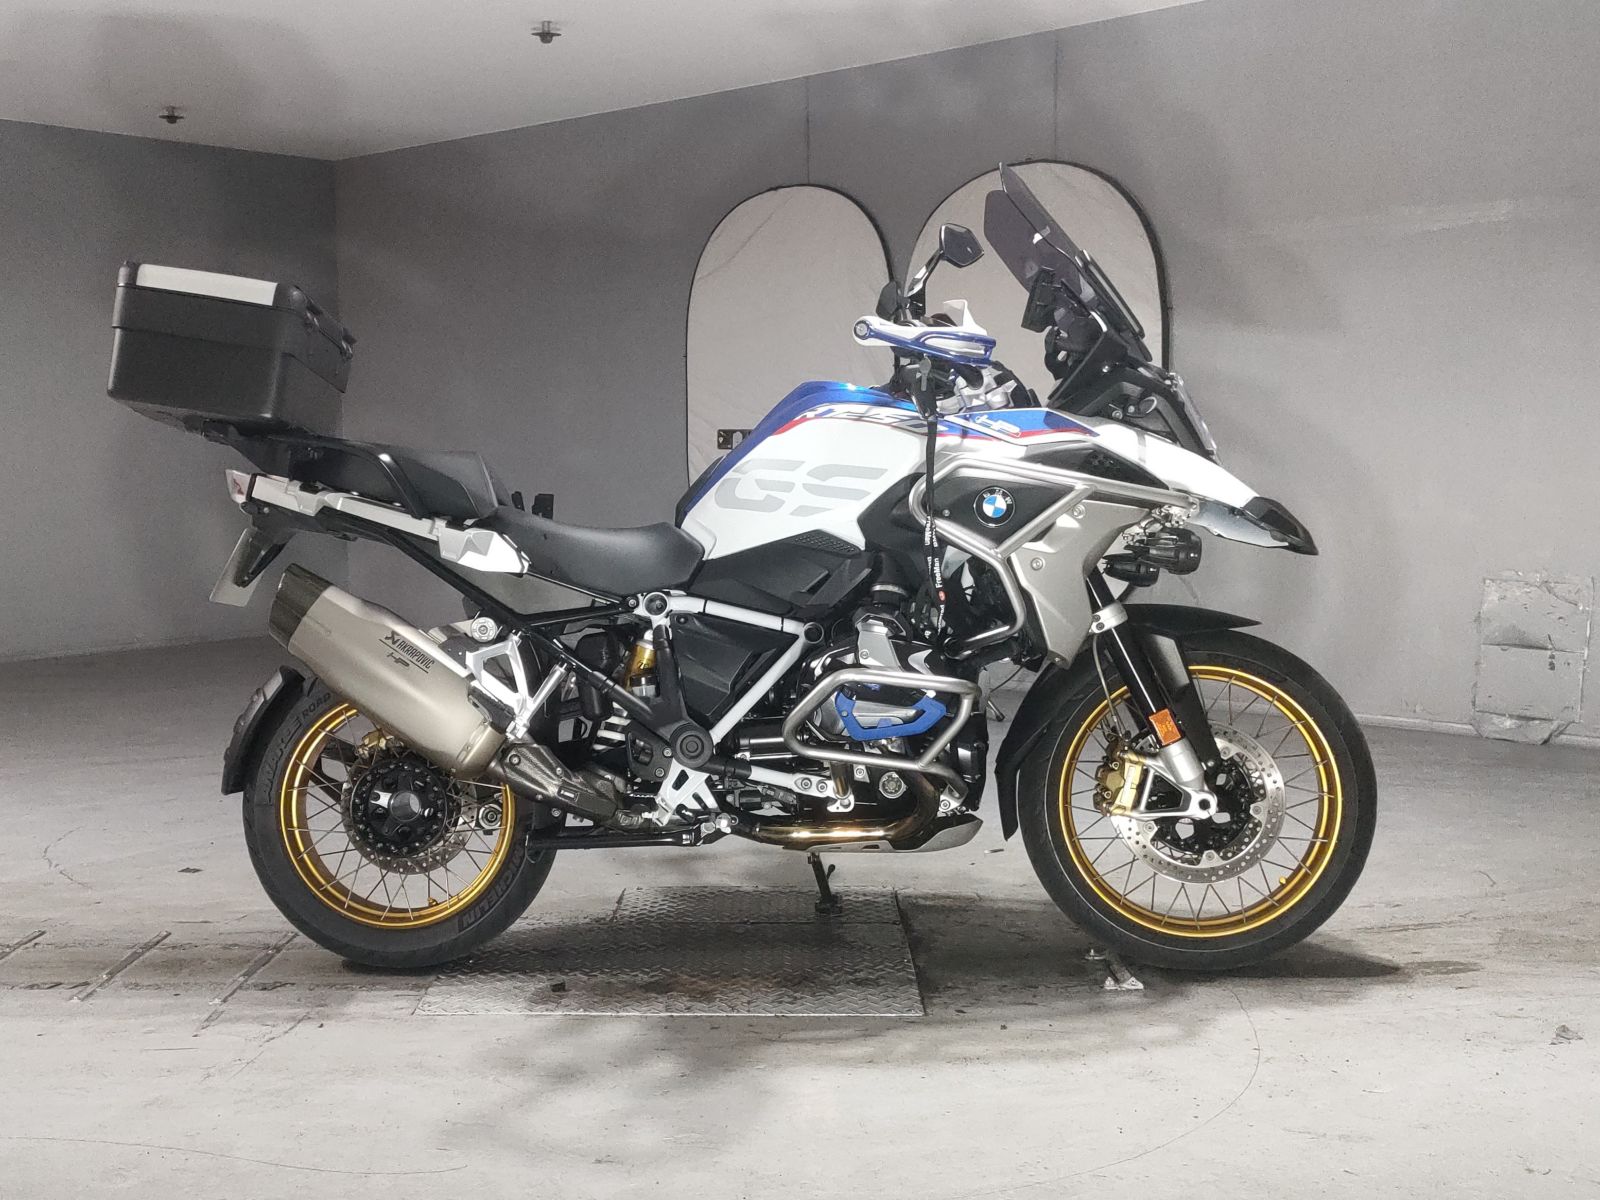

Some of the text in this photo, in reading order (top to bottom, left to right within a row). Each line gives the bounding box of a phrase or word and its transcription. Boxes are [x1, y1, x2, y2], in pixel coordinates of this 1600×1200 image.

[974, 414, 1021, 438] HP
[714, 458, 888, 518] GS
[983, 489, 1013, 505] BMW
[933, 557, 943, 588] FreeMan
[386, 652, 410, 667] HP
[301, 692, 332, 719] ROAD
